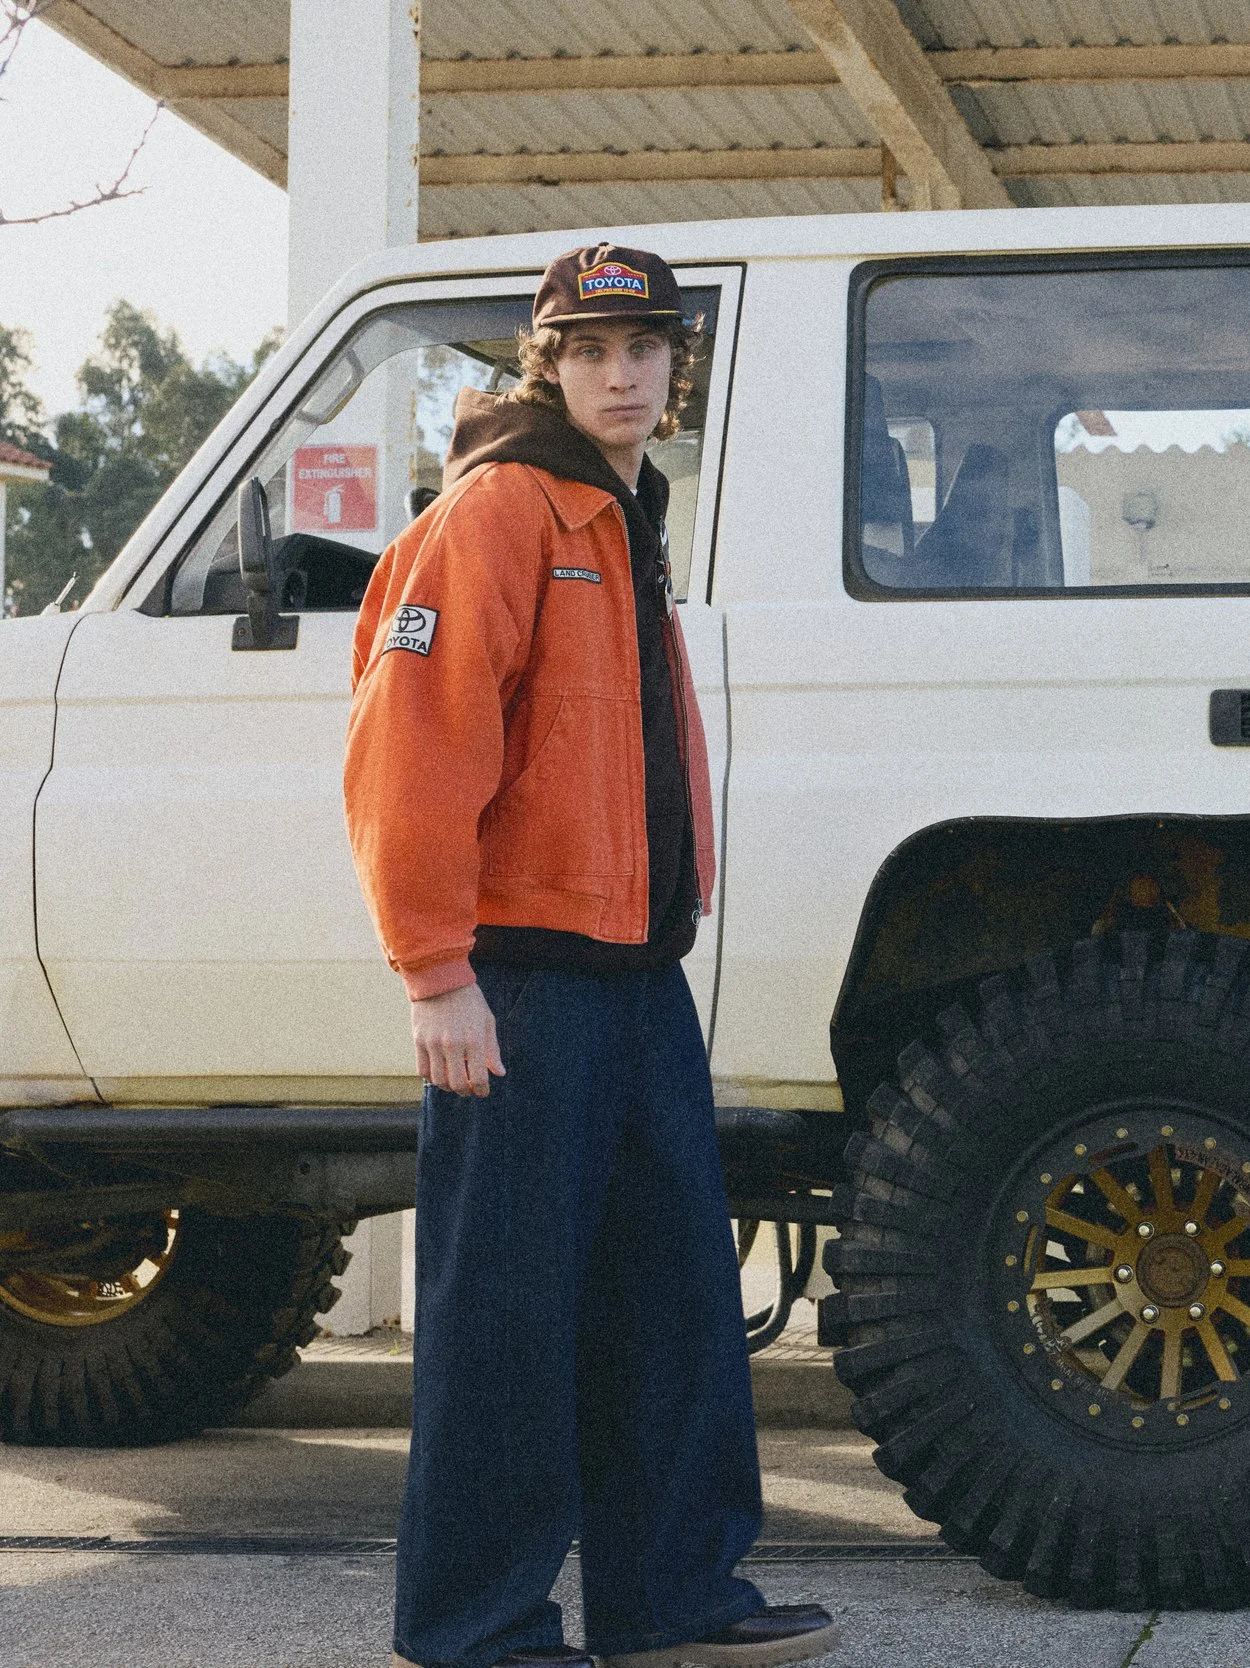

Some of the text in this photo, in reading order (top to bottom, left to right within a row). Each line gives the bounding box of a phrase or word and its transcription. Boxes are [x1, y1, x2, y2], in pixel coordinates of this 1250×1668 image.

[586, 276, 642, 290] TOYOTA
[323, 453, 346, 464] FIRE
[386, 636, 428, 652] OYOTA
